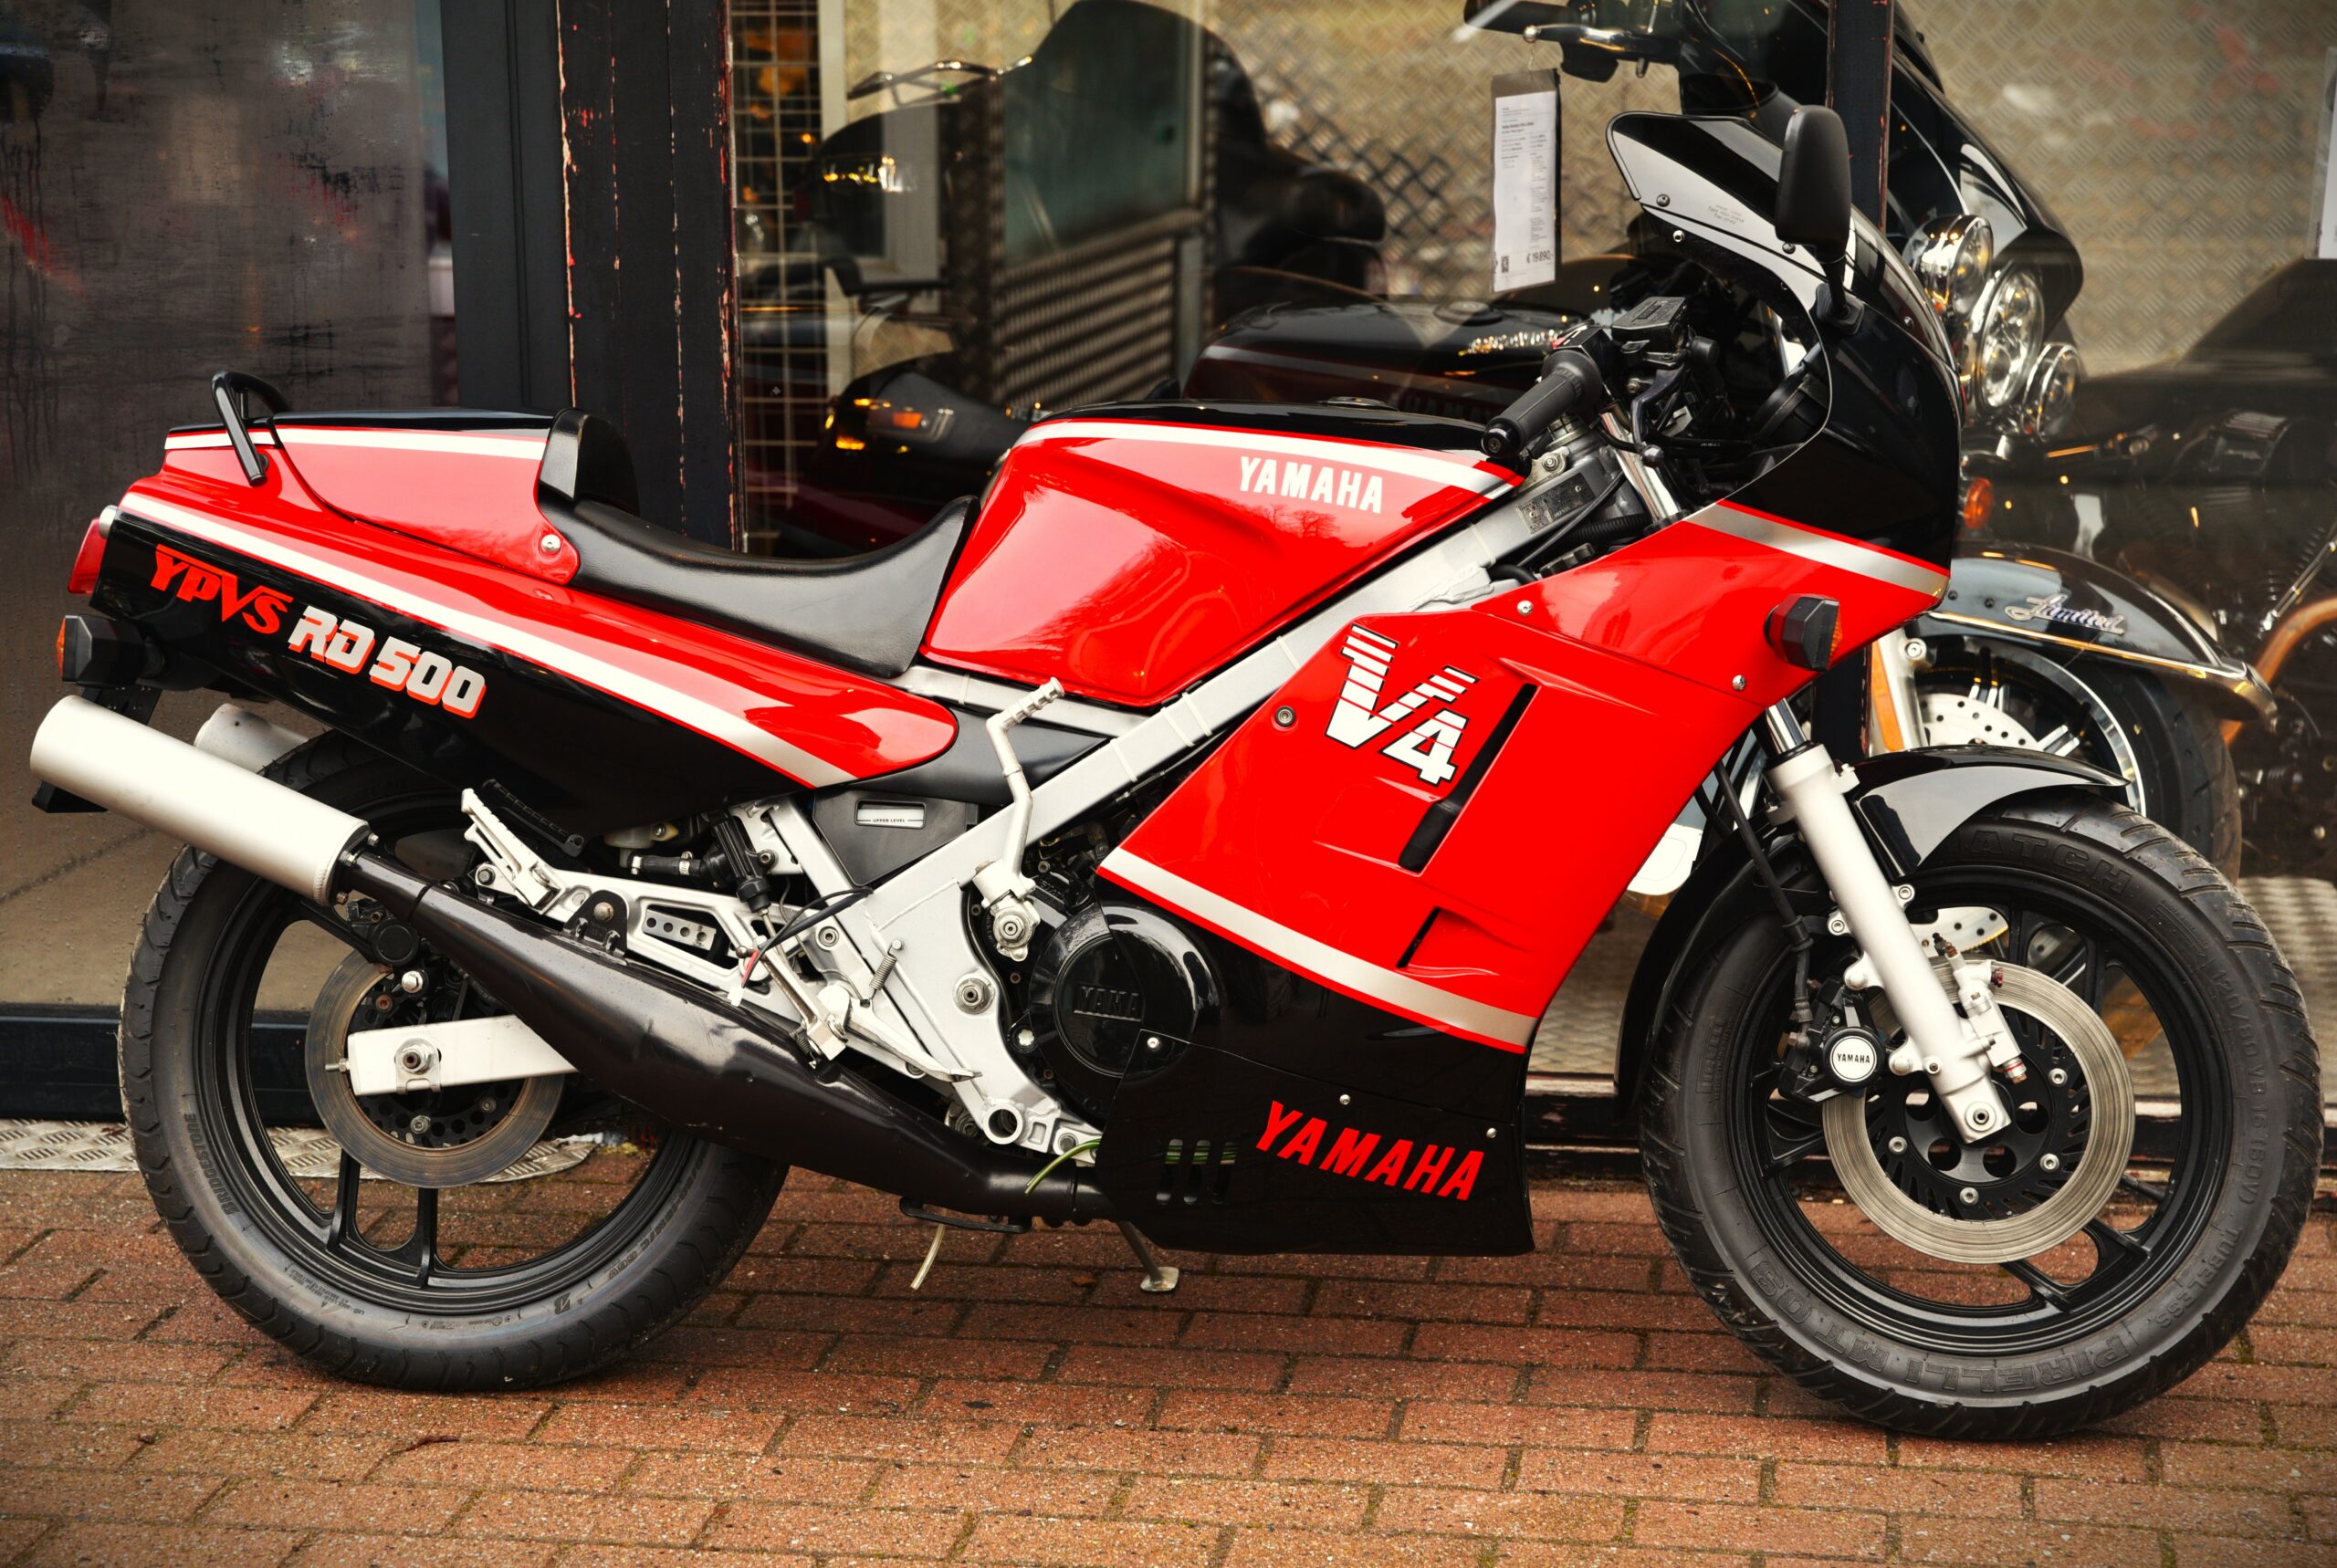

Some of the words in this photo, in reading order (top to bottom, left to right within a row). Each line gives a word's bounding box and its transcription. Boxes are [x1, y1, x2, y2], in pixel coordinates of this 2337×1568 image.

[1240, 455, 1383, 514] YAMAHA
[150, 544, 293, 634] YPVS
[288, 604, 376, 674] RD
[369, 635, 487, 719] 500
[1326, 622, 1480, 787] V4
[1947, 829, 2133, 894] ATCH
[1080, 986, 1140, 1018] YAMA
[1837, 1053, 1871, 1064] YAMAHA
[184, 1113, 240, 1215] BRIDGESTONE
[1255, 1100, 1484, 1201] YAMAHA
[2155, 1227, 2240, 1329] TUBELESS
[1813, 1325, 1890, 1374] MT
[1906, 1333, 2131, 1393] PIRELLI
